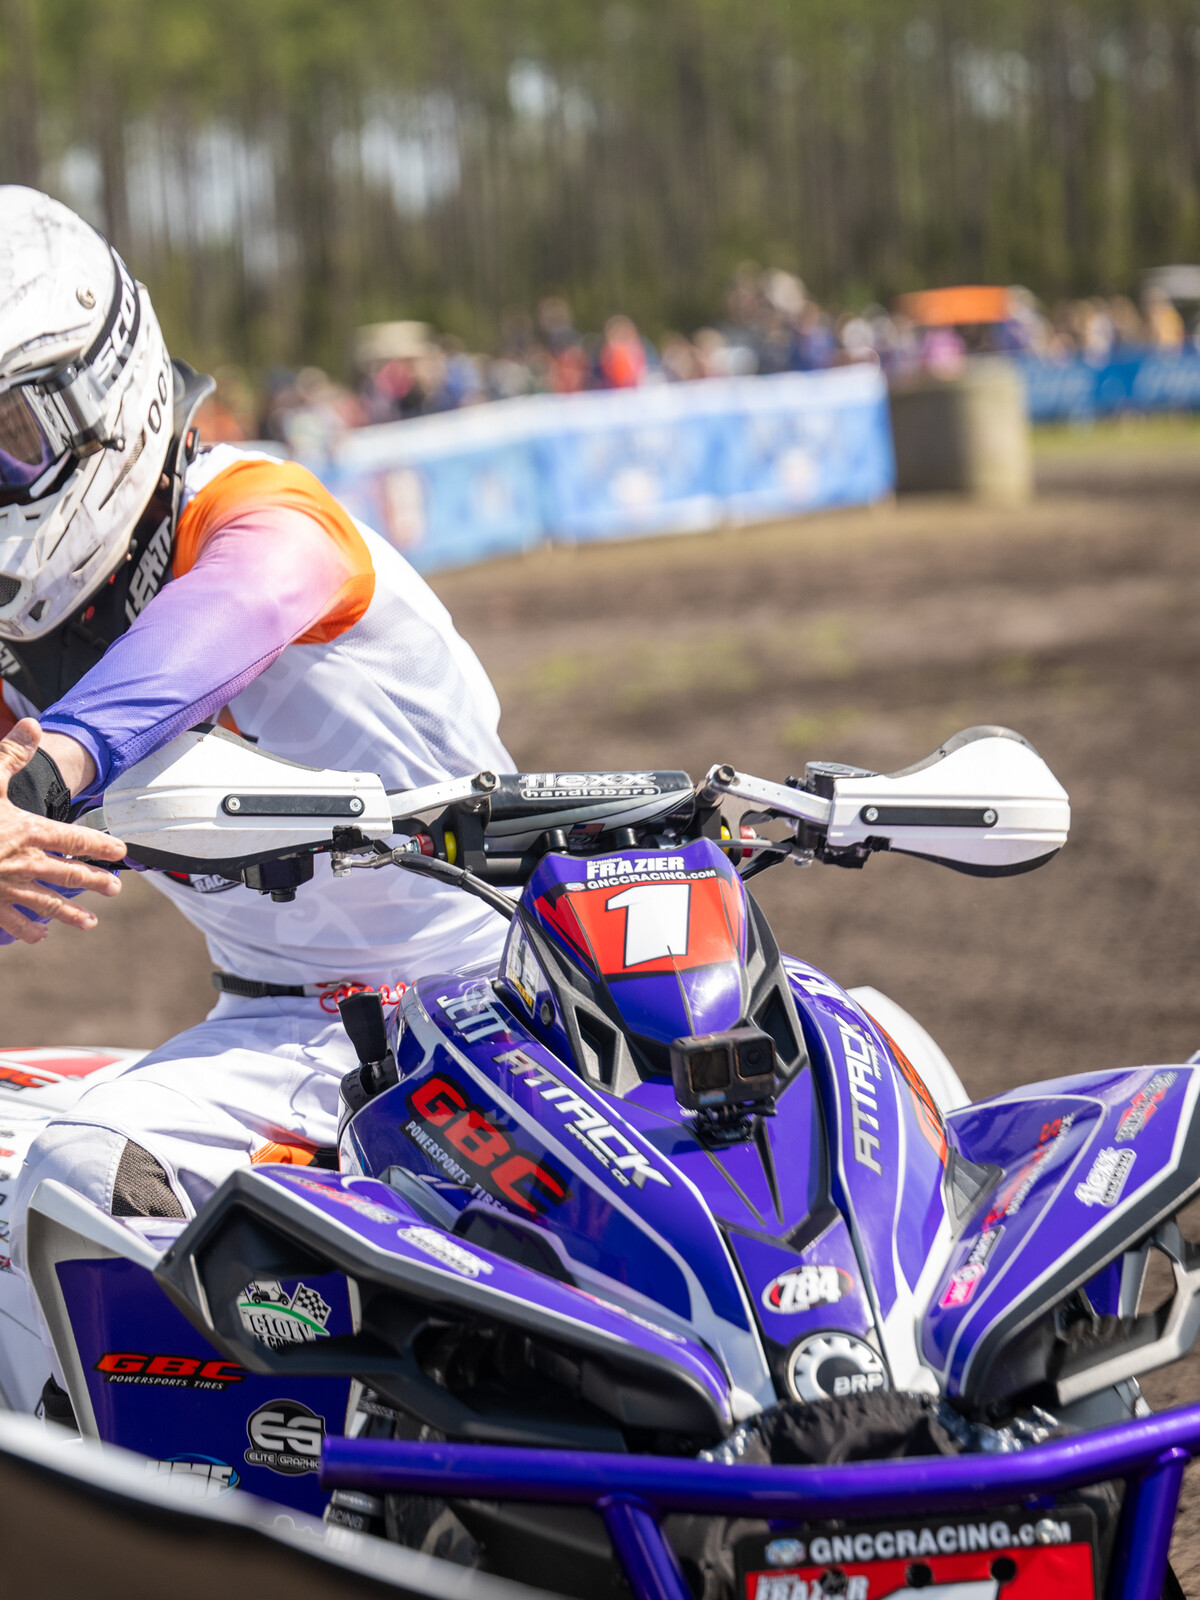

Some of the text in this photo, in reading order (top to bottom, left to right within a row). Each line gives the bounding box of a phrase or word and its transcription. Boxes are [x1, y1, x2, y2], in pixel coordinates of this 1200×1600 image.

[526, 787, 655, 797] handlebars
[586, 856, 685, 880] FRAZIER
[587, 869, 717, 890] GNCCRACING.COM
[605, 883, 691, 969] 1
[834, 1013, 882, 1177] ATTACK
[492, 1048, 672, 1189] ATTACK
[404, 1120, 471, 1186] POWERSPORTS
[410, 1077, 567, 1221] GBC
[98, 1354, 246, 1381] GBC
[108, 1375, 225, 1391] POWERSPORTS TIRES
[833, 1373, 885, 1397] BRP
[248, 1452, 321, 1470] ELITE GRAPHIC
[810, 1520, 1072, 1564] GNCCRACING.CM
